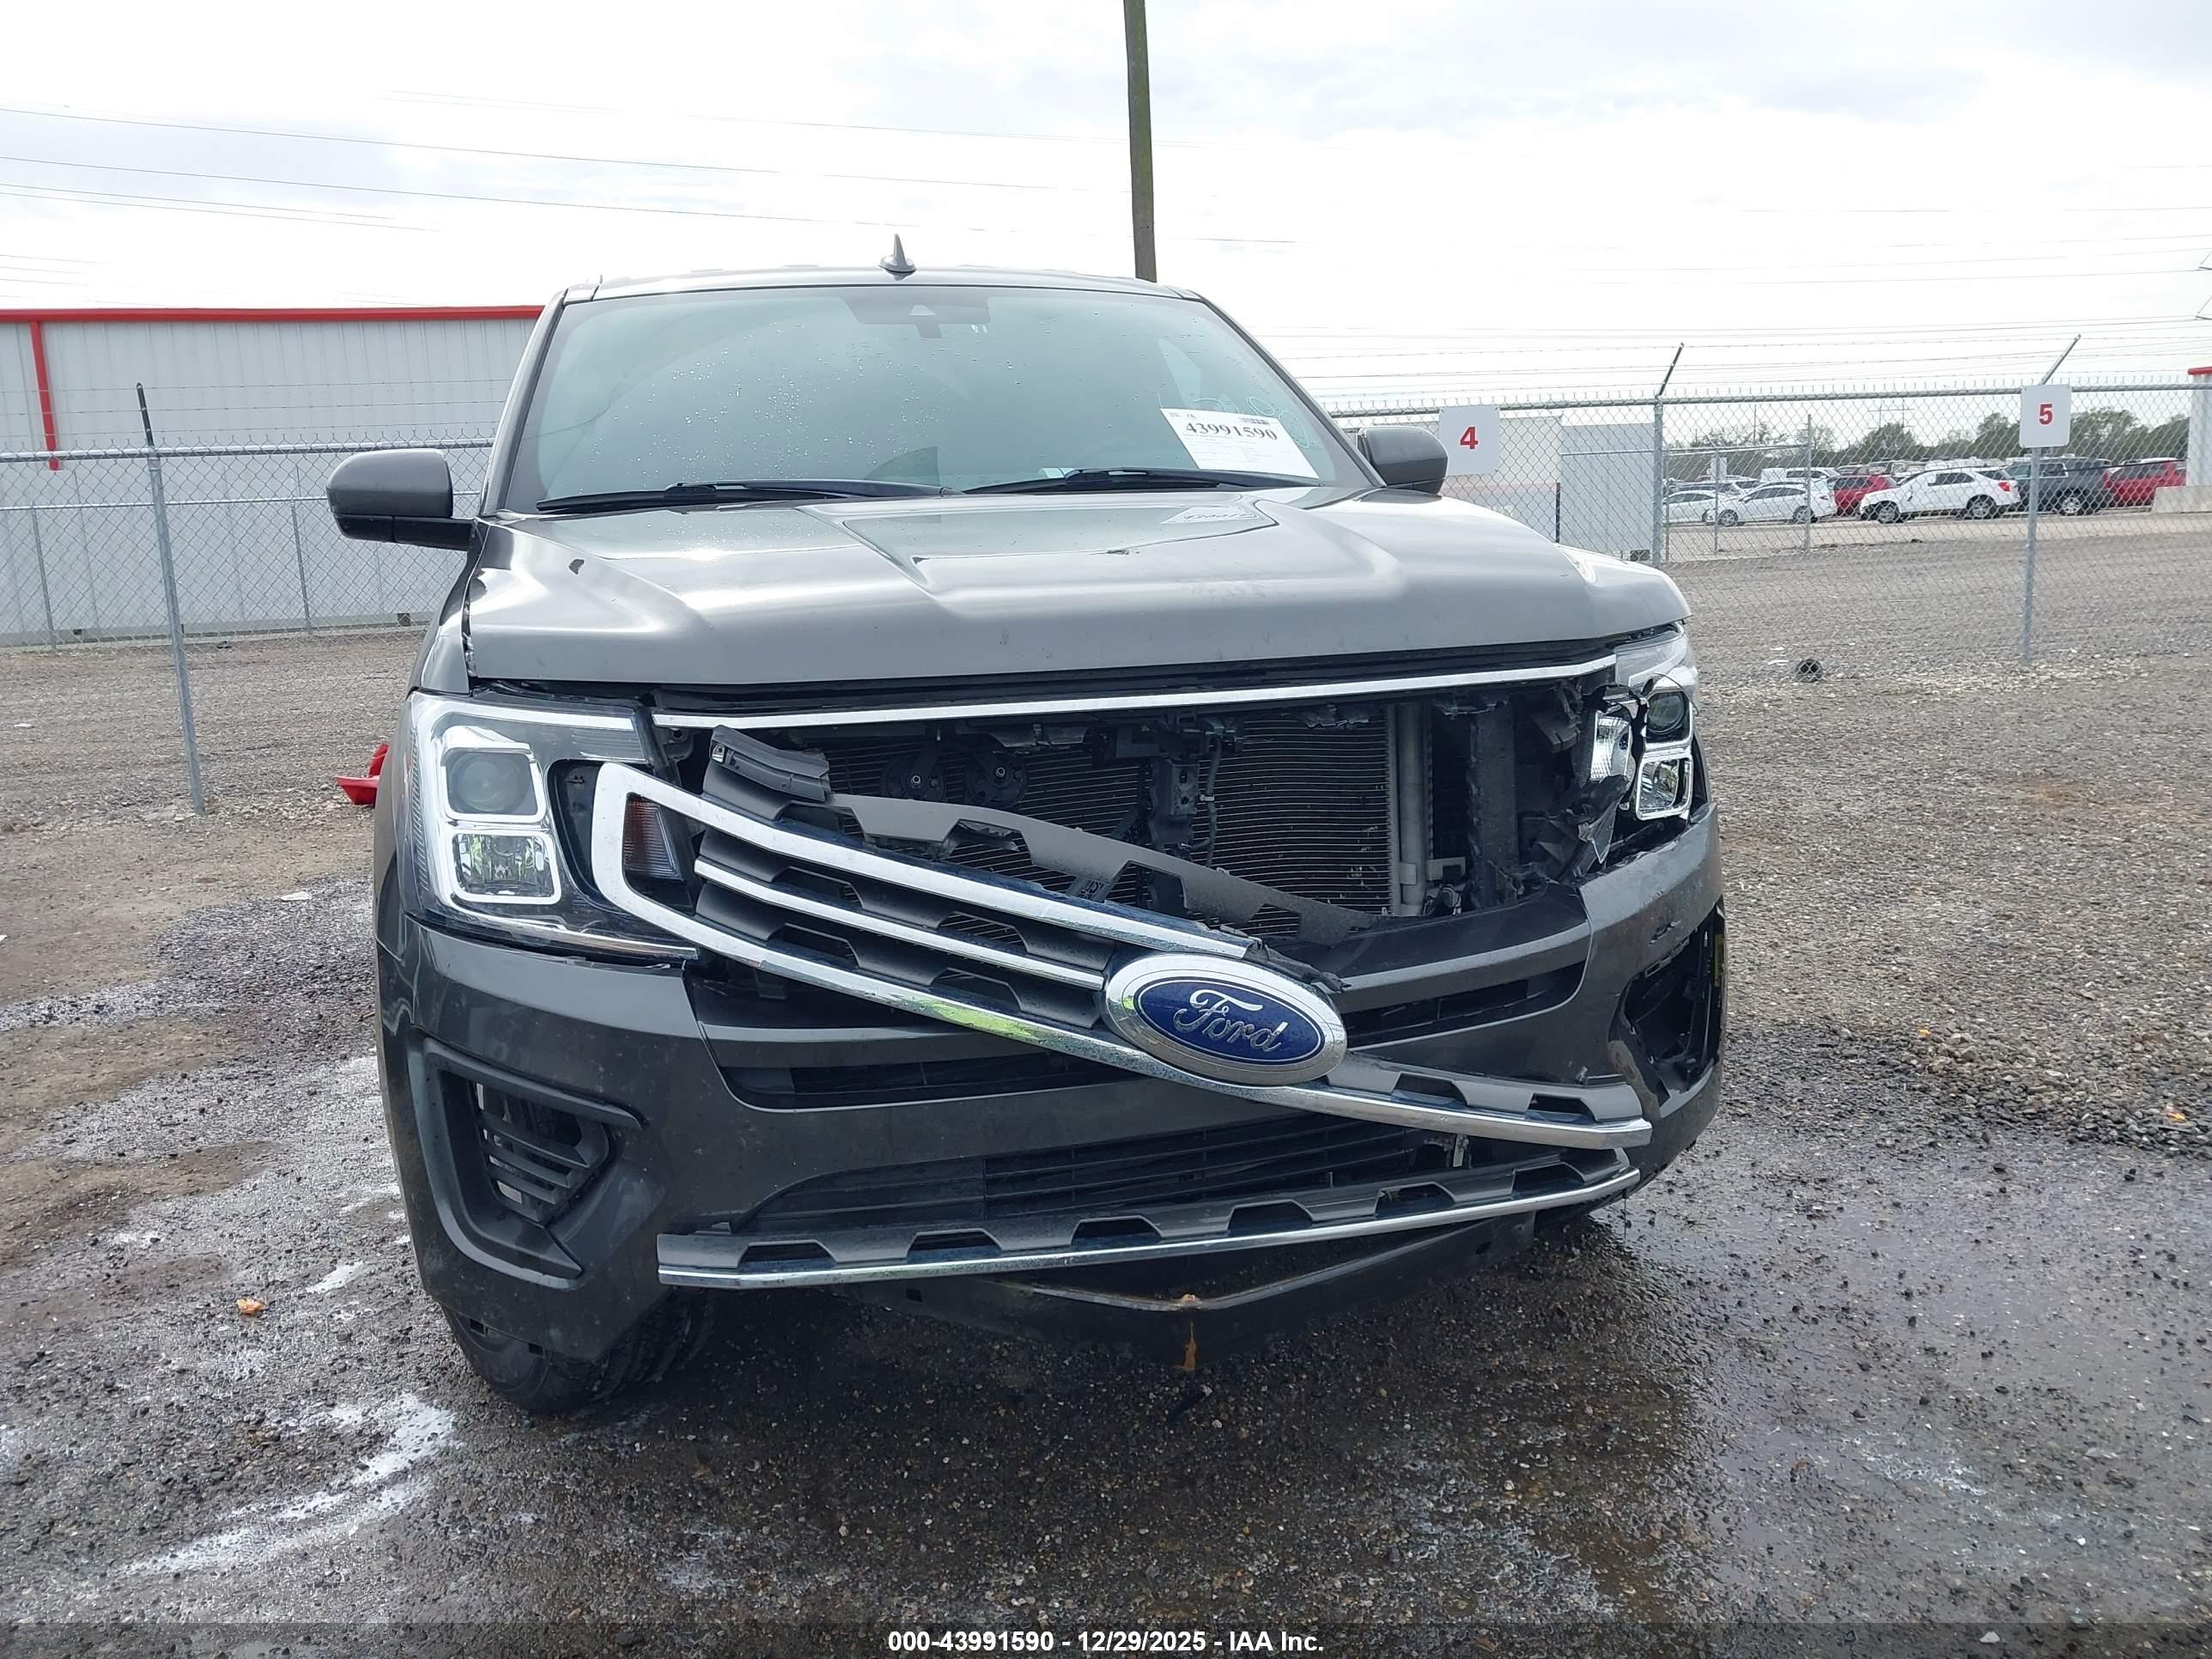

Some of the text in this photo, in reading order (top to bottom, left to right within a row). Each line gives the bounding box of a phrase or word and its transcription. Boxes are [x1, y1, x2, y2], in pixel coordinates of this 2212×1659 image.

[2039, 404, 2052, 425] 5
[1186, 422, 1278, 441] 43991590
[1459, 426, 1478, 450] 4
[1172, 988, 1289, 1053] Ford
